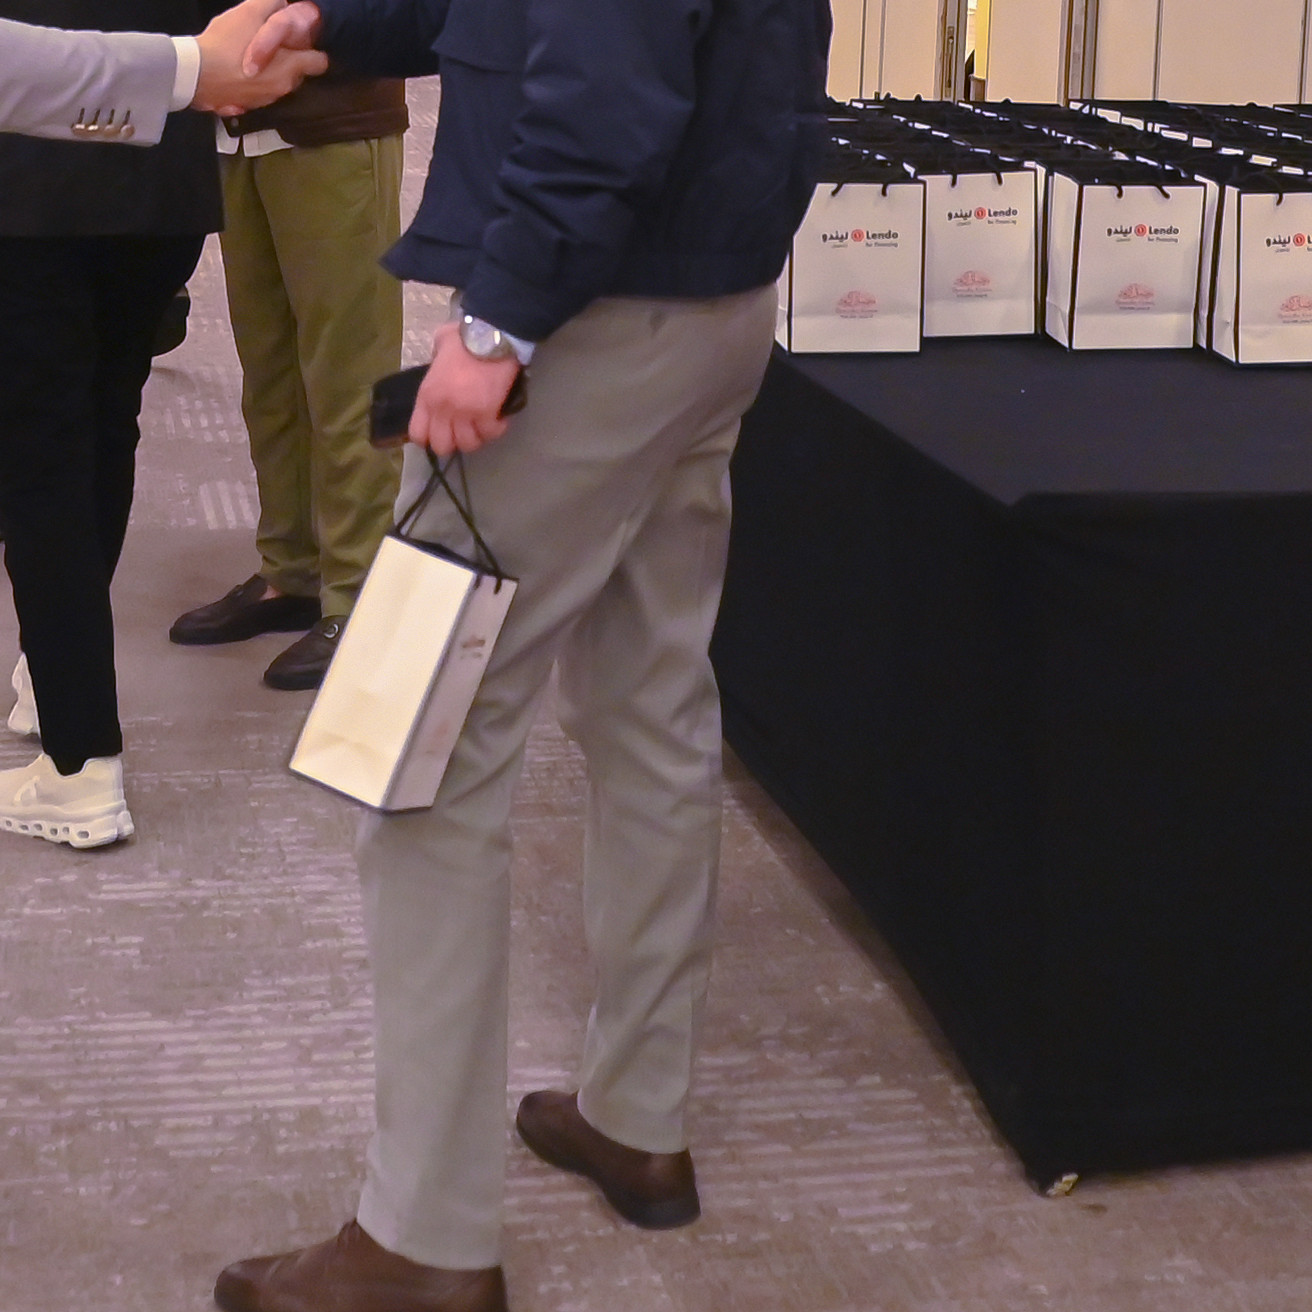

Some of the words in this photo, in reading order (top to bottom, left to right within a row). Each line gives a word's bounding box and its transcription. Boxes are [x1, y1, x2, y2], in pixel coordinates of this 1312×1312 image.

[988, 207, 1018, 218] Lendo
[866, 229, 899, 240] Lendo
[1149, 225, 1179, 235] Lendo
